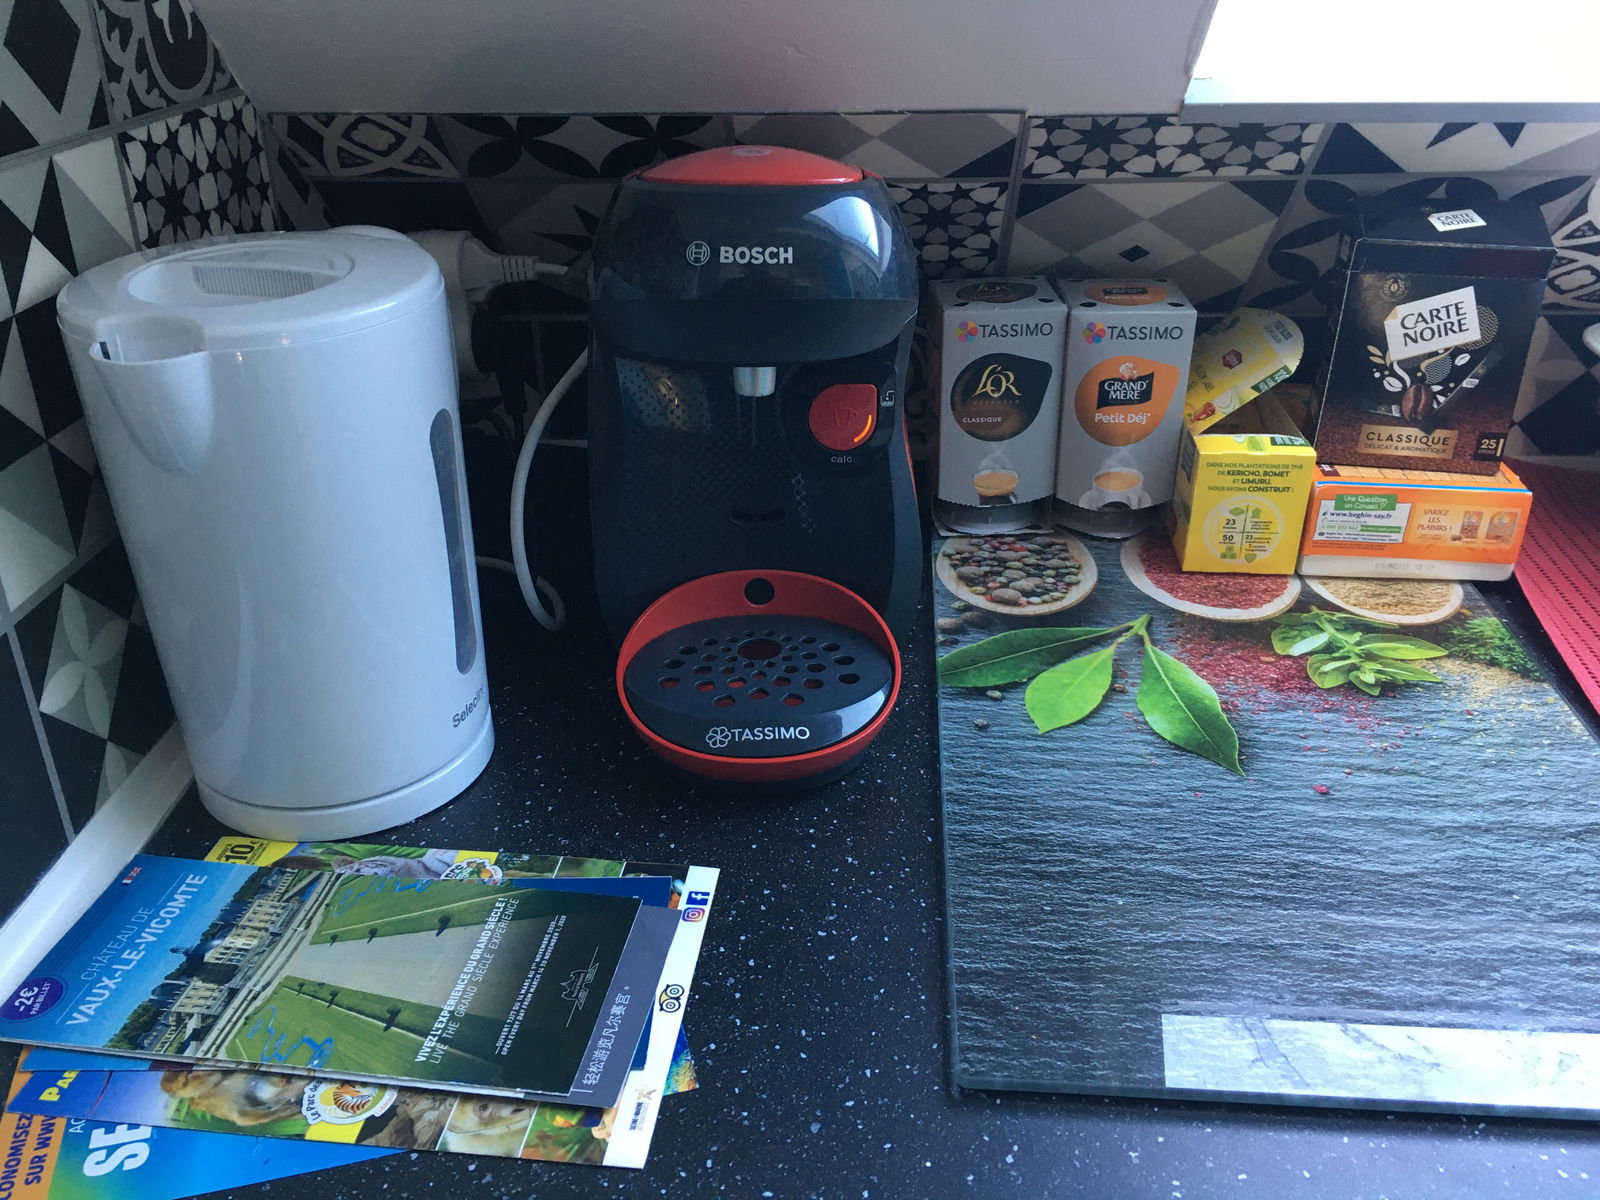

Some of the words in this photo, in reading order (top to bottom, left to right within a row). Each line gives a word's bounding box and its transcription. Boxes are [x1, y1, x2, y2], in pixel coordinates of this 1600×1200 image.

[1437, 212, 1474, 221] CARTE
[1441, 218, 1479, 226] NOIRE
[719, 246, 794, 264] BOSCH
[1400, 301, 1467, 330] CARTE
[978, 322, 1053, 338] TASSIMO
[1107, 326, 1184, 340] TASSIMO
[1403, 317, 1470, 347] NOIRE
[962, 416, 1002, 424] CLASSIQUE
[1094, 412, 1125, 424] Petit
[1366, 431, 1450, 447] CLASSIQUE
[1481, 438, 1497, 449] 25
[1400, 445, 1449, 454] AROMATIQUE
[830, 455, 853, 464] calc
[1226, 469, 1262, 477] KERICHO,
[1354, 502, 1379, 510] Conseil
[1423, 508, 1450, 516] VARIEZ
[1225, 518, 1236, 526] 23
[1329, 511, 1392, 520] www.beghin-say.fr
[1417, 524, 1448, 532] PLAISIRS
[1222, 534, 1234, 542] 50
[731, 727, 810, 742] TASSIMO
[65, 873, 208, 1025] VAUX-LE-VICOMTE
[81, 925, 138, 981] CHÂTEAU
[133, 907, 154, 923] DE
[470, 931, 492, 961] GRAND
[464, 961, 478, 974] DU
[429, 1041, 448, 1064] LIVE
[442, 1021, 460, 1039] THE
[454, 984, 478, 1018] GRAND
[488, 898, 520, 950] EXPERIENCE
[500, 1039, 512, 1056] OPEN
[508, 1020, 520, 1040] EVERY
[516, 1008, 526, 1021] DAY
[521, 993, 534, 1009] FROM
[529, 974, 542, 994] MARCH
[544, 932, 560, 961] NOVEMBER
[558, 914, 568, 927] 2020
[495, 1024, 509, 1048] OUVERT
[519, 977, 532, 995] MARS
[535, 934, 552, 963] NOVEMBRE
[14, 986, 39, 1012] -2€
[30, 1002, 42, 1015] PAR
[415, 1036, 439, 1063] VIVEZ
[306, 1093, 317, 1112] Parc
[310, 1111, 322, 1121] Le
[24, 1153, 48, 1186] SUR
